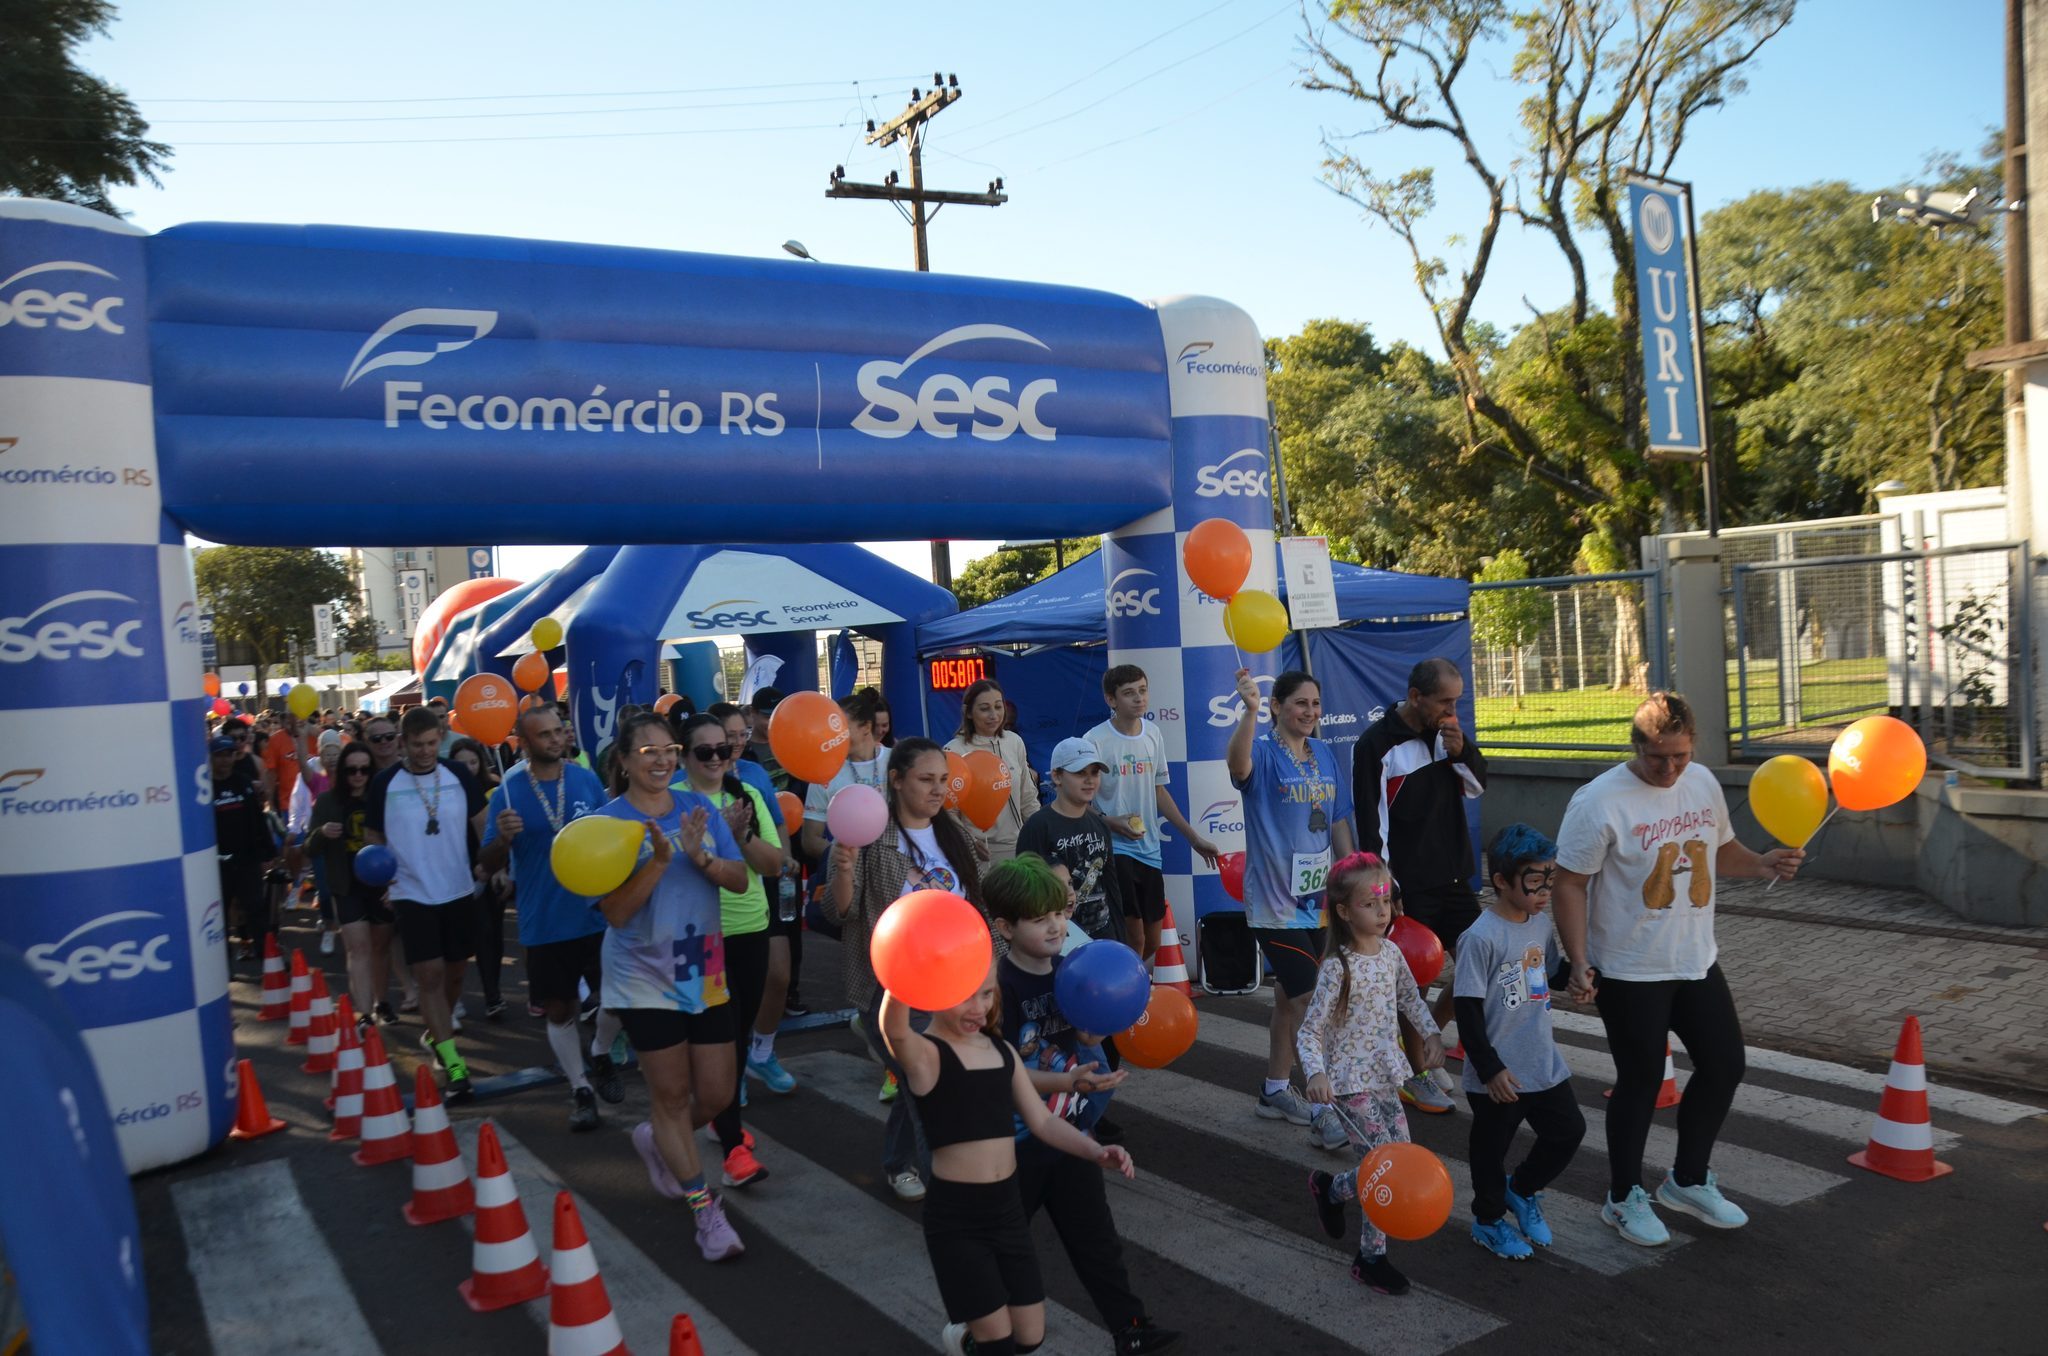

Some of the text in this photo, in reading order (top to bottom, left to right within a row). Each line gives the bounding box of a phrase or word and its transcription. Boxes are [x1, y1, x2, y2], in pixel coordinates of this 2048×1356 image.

[0, 288, 125, 335] esc
[1187, 359, 1258, 377] Fecomércio
[1647, 266, 1684, 441] URI
[383, 380, 787, 437] Fecomércio RS
[850, 358, 1058, 442] Sesc
[0, 464, 153, 488] comércio RS
[1195, 464, 1269, 498] Sesc
[686, 609, 777, 631] Sesc
[782, 598, 859, 615] Fecomércio
[1159, 708, 1180, 721] RS
[1318, 713, 1357, 726] ndicatos
[2, 785, 172, 815] Fecomércio RS
[1056, 831, 1101, 851] SKATE ALL
[1299, 865, 1329, 893] 362
[25, 933, 172, 989] Sesc
[115, 1093, 202, 1127] ércio RS
